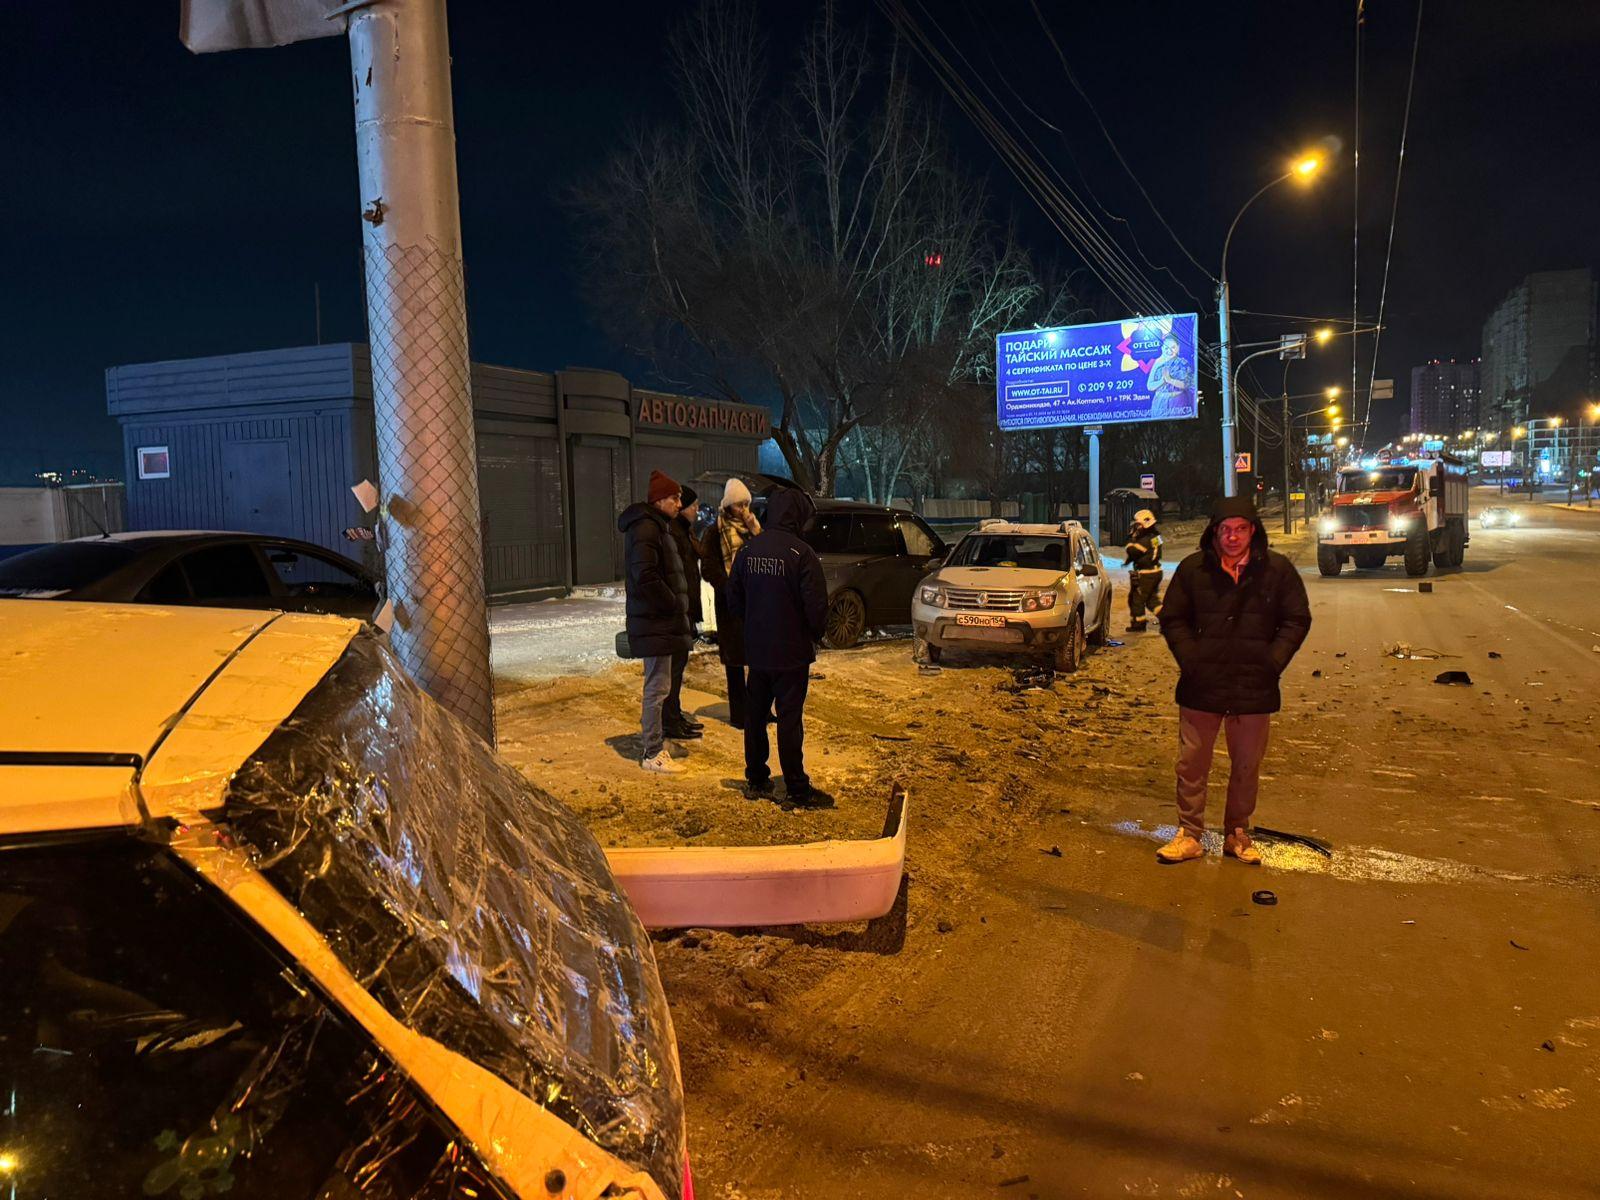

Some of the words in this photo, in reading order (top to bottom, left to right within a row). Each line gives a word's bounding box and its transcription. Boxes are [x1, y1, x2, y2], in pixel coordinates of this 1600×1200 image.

[1005, 349, 1057, 364] ТАЙСКИЙ
[1060, 344, 1112, 359] МАССАЖ
[1012, 364, 1063, 375] СЕРТИФИКАТА
[1065, 362, 1077, 370] ПО
[1078, 361, 1097, 370] ЦЕНЕ
[1011, 387, 1063, 397] WWW.OT-TAI.RU
[1088, 383, 1105, 392] 209
[1107, 382, 1113, 390] 9
[1116, 380, 1134, 389] 209
[638, 397, 767, 434] АВТОЗАПЧАСТИ
[747, 557, 785, 576] RUSSIA
